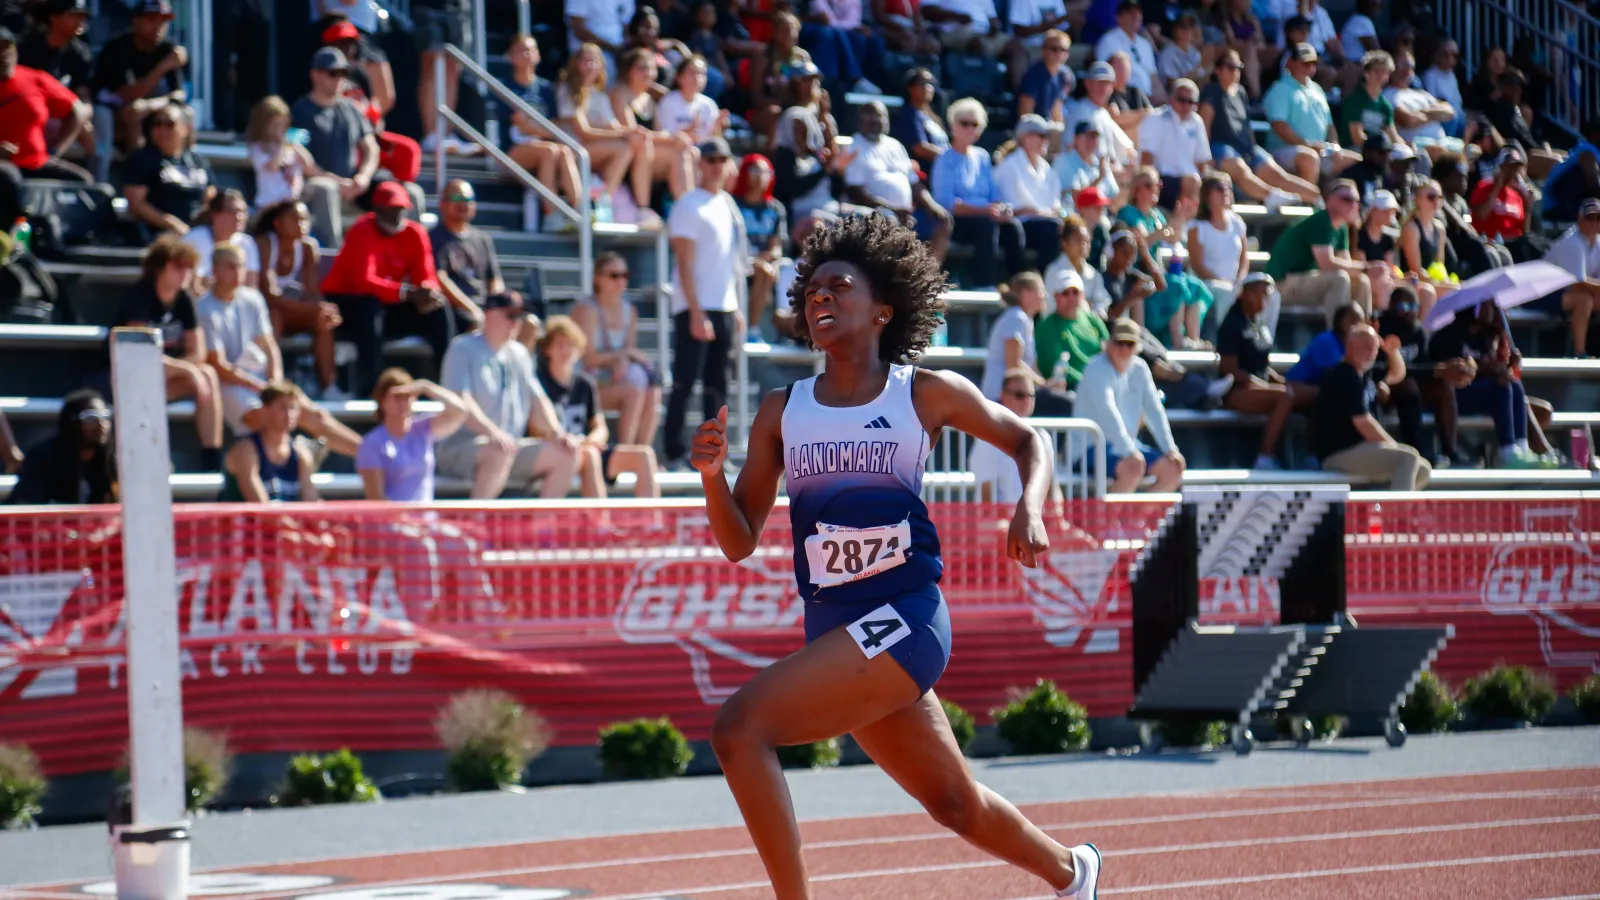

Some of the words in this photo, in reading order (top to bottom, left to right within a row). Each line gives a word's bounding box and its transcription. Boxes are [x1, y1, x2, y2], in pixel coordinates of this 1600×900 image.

[790, 441, 898, 480] LANDMARK
[853, 569, 881, 581] ATLANTA
[859, 618, 904, 650] 4
[103, 643, 264, 688] TACK
[296, 640, 415, 675] CLUB
